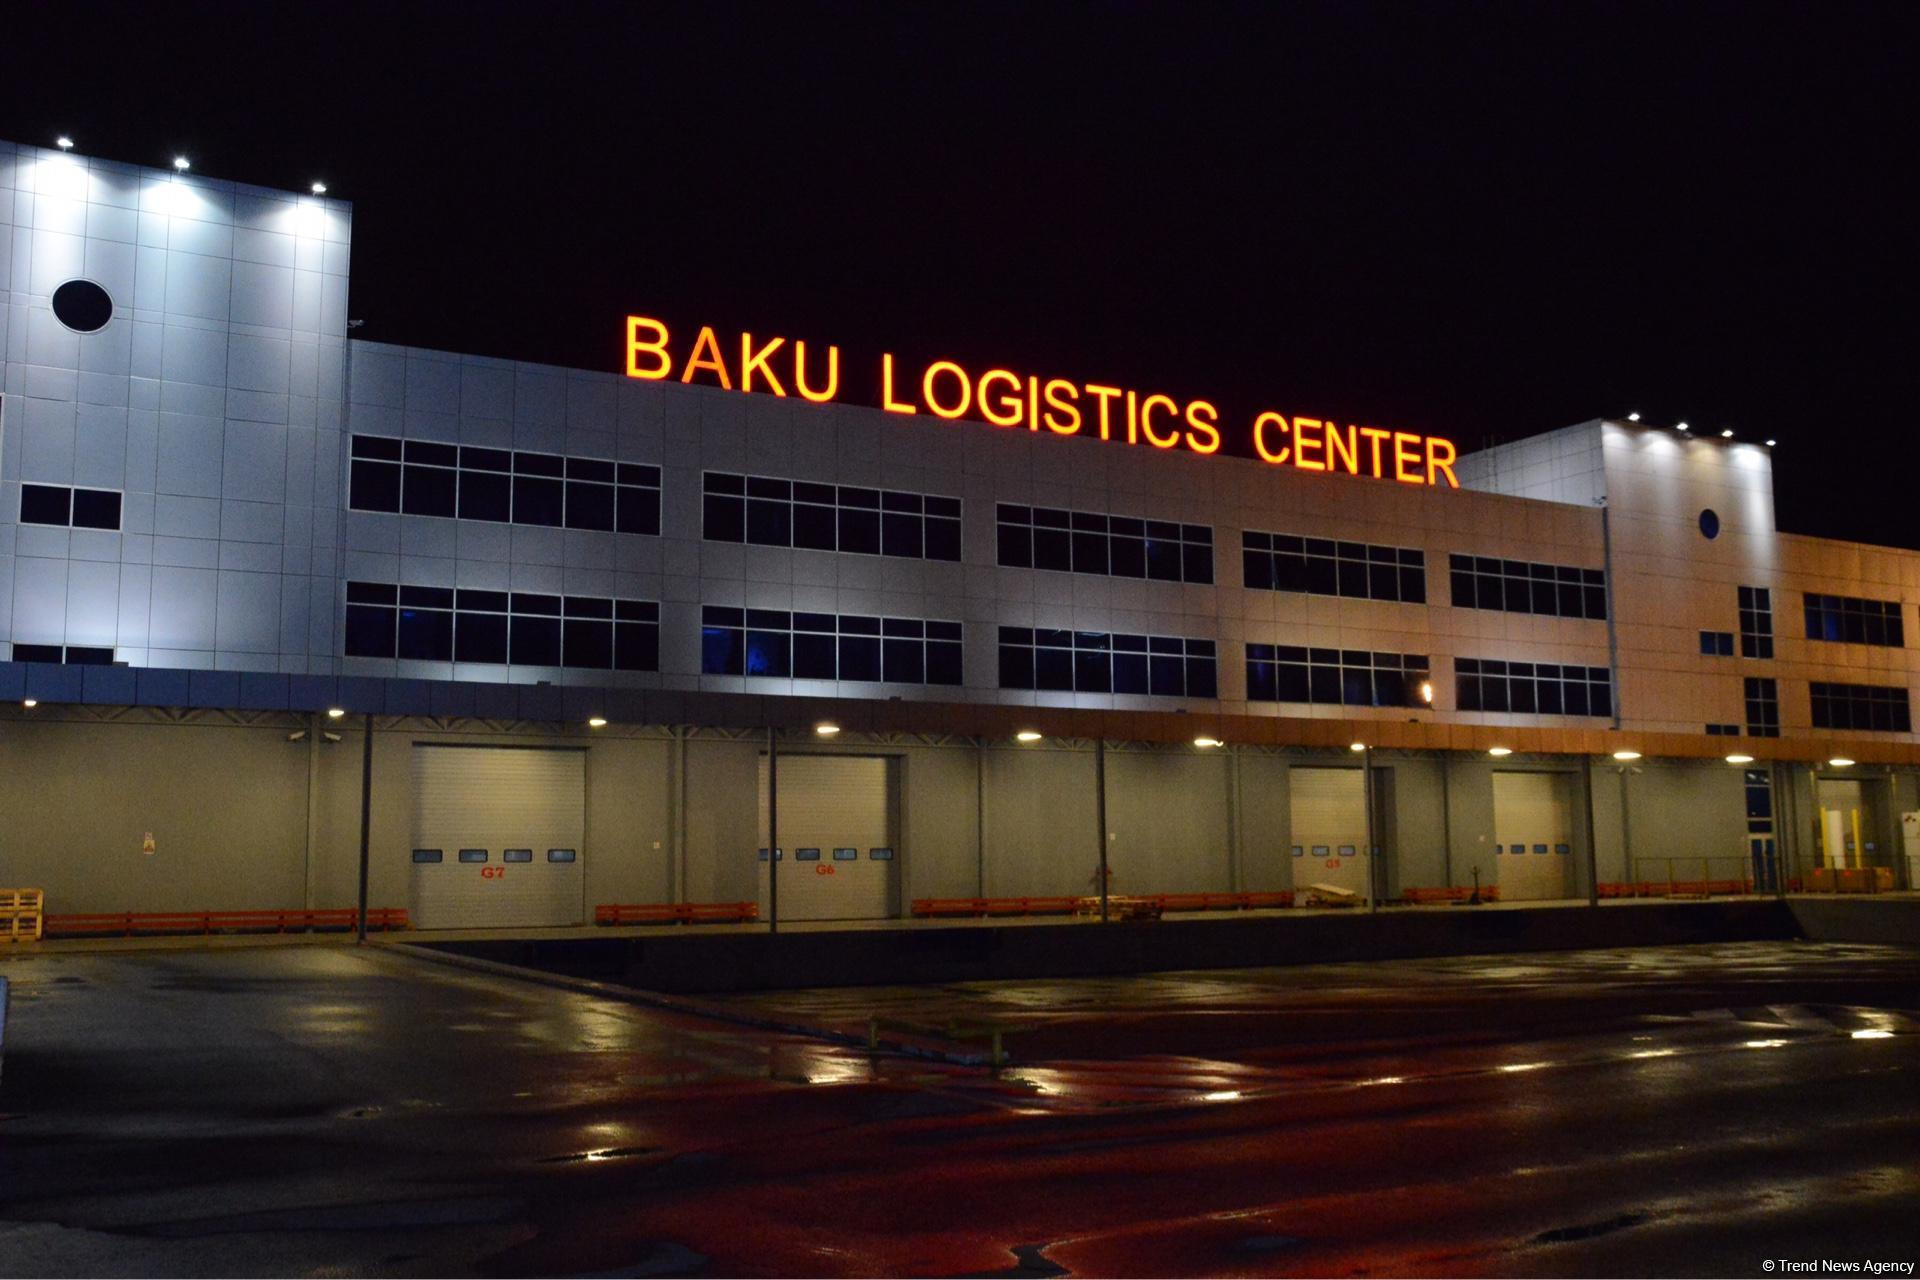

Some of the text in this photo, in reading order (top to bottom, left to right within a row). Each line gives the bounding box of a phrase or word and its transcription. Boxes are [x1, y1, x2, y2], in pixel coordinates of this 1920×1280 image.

[625, 314, 1461, 490] BAKU LOGISTICS CENTER
[481, 866, 505, 879] G7
[815, 864, 835, 876] G6
